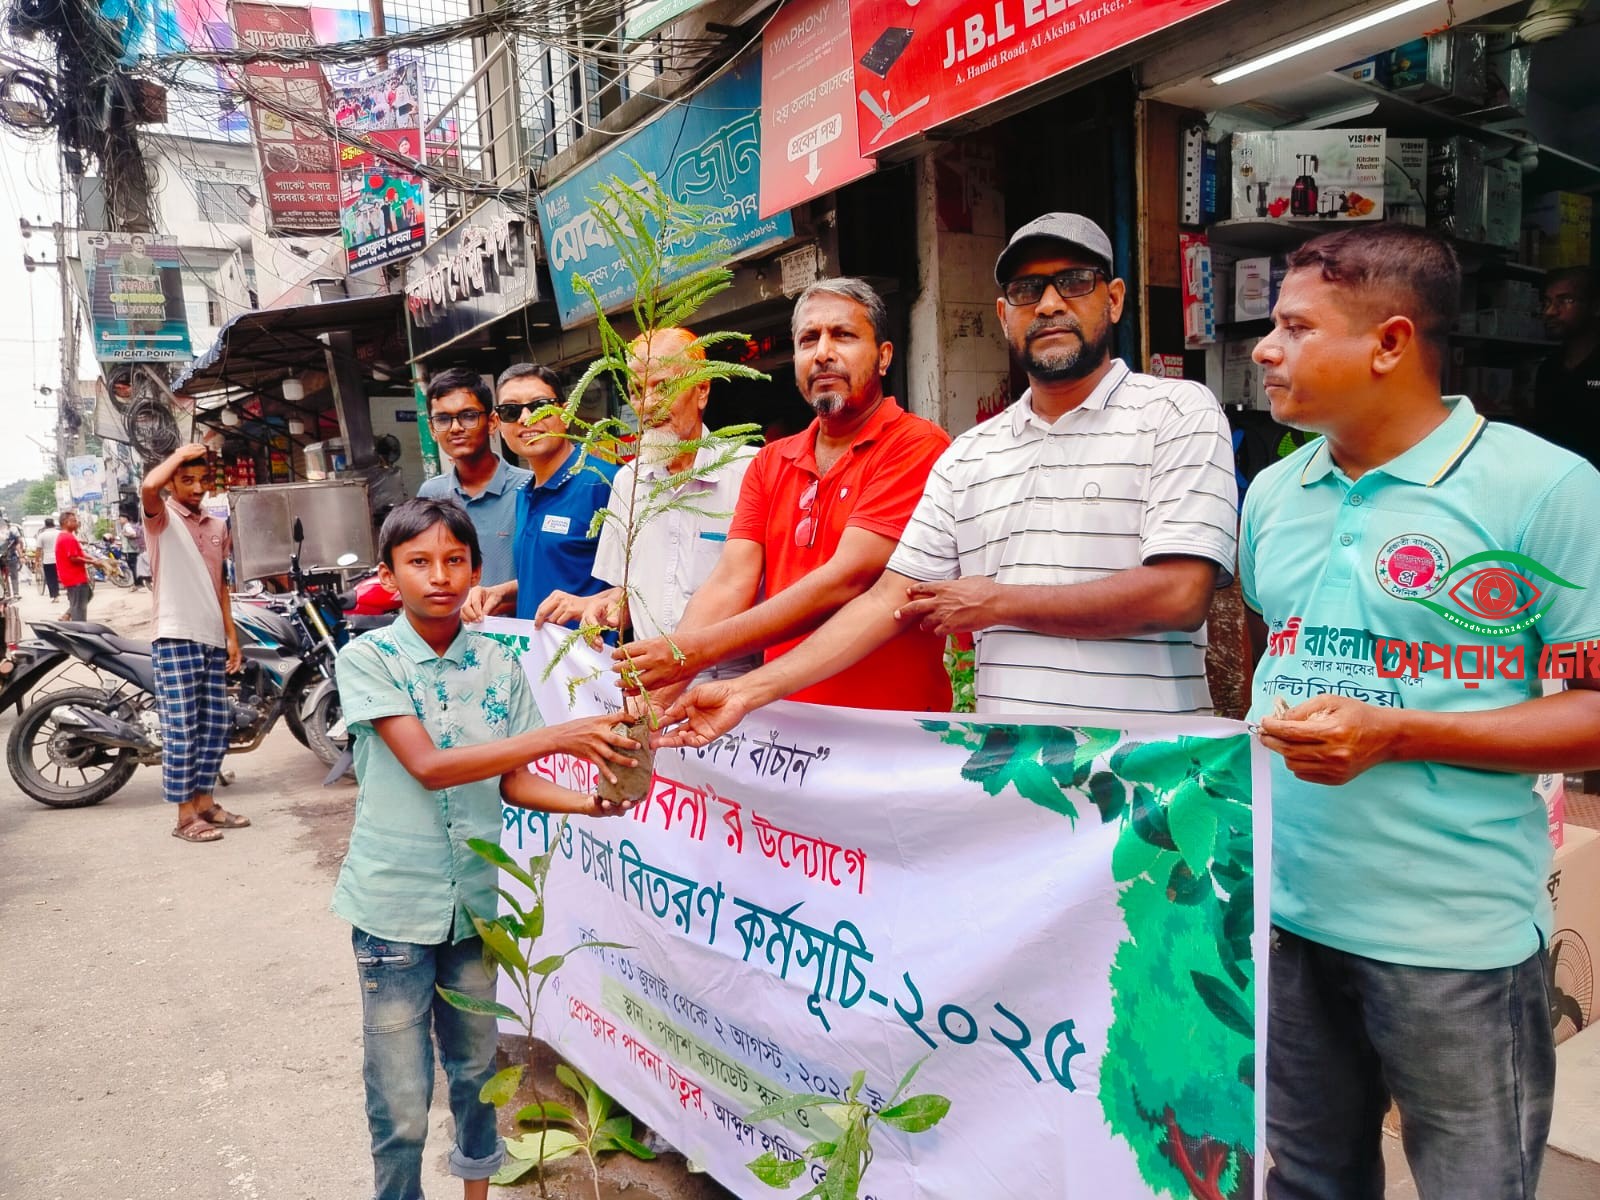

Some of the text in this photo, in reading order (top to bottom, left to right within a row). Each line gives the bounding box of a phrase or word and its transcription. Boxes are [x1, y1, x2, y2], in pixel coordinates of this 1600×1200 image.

[769, 5, 830, 58] SYMPHONY
[943, 2, 1016, 69] J.B.L
[967, 55, 998, 79] Hamid
[1000, 42, 1028, 64] Road,
[1030, 34, 1042, 50] Al
[1044, 19, 1077, 44] Aksha
[1078, 0, 1125, 27] Market,
[790, 117, 838, 154] প্রবেশ পথ
[1347, 134, 1382, 143] VISION
[1356, 155, 1380, 163] Kitchen
[1356, 163, 1380, 171] Master
[387, 230, 412, 247] পাবনা
[113, 350, 176, 358] RIGHT POINT
[1391, 584, 1419, 597] দৈনিক
[1399, 571, 1417, 586] প্র
[1301, 658, 1376, 678] বাংলার মানুষের
[751, 808, 868, 895] উদ্যোগে
[579, 827, 614, 893] চারা
[618, 838, 726, 945] বিতরণ
[732, 900, 1087, 1094] কর্মসূচি-২০২৫
[617, 956, 634, 981] ৩১
[636, 966, 671, 1009] জুলাই
[673, 992, 708, 1029] থেকে
[714, 1015, 727, 1045] ২
[568, 995, 617, 1049] প্রেসক্লাব
[621, 1033, 663, 1085] পাবনা
[711, 1099, 756, 1147] আব্দুল
[622, 994, 644, 1025] স্থান
[657, 1020, 692, 1062] পলাশ
[695, 1044, 749, 1093] ক্যাডেট
[794, 1108, 810, 1129] ও
